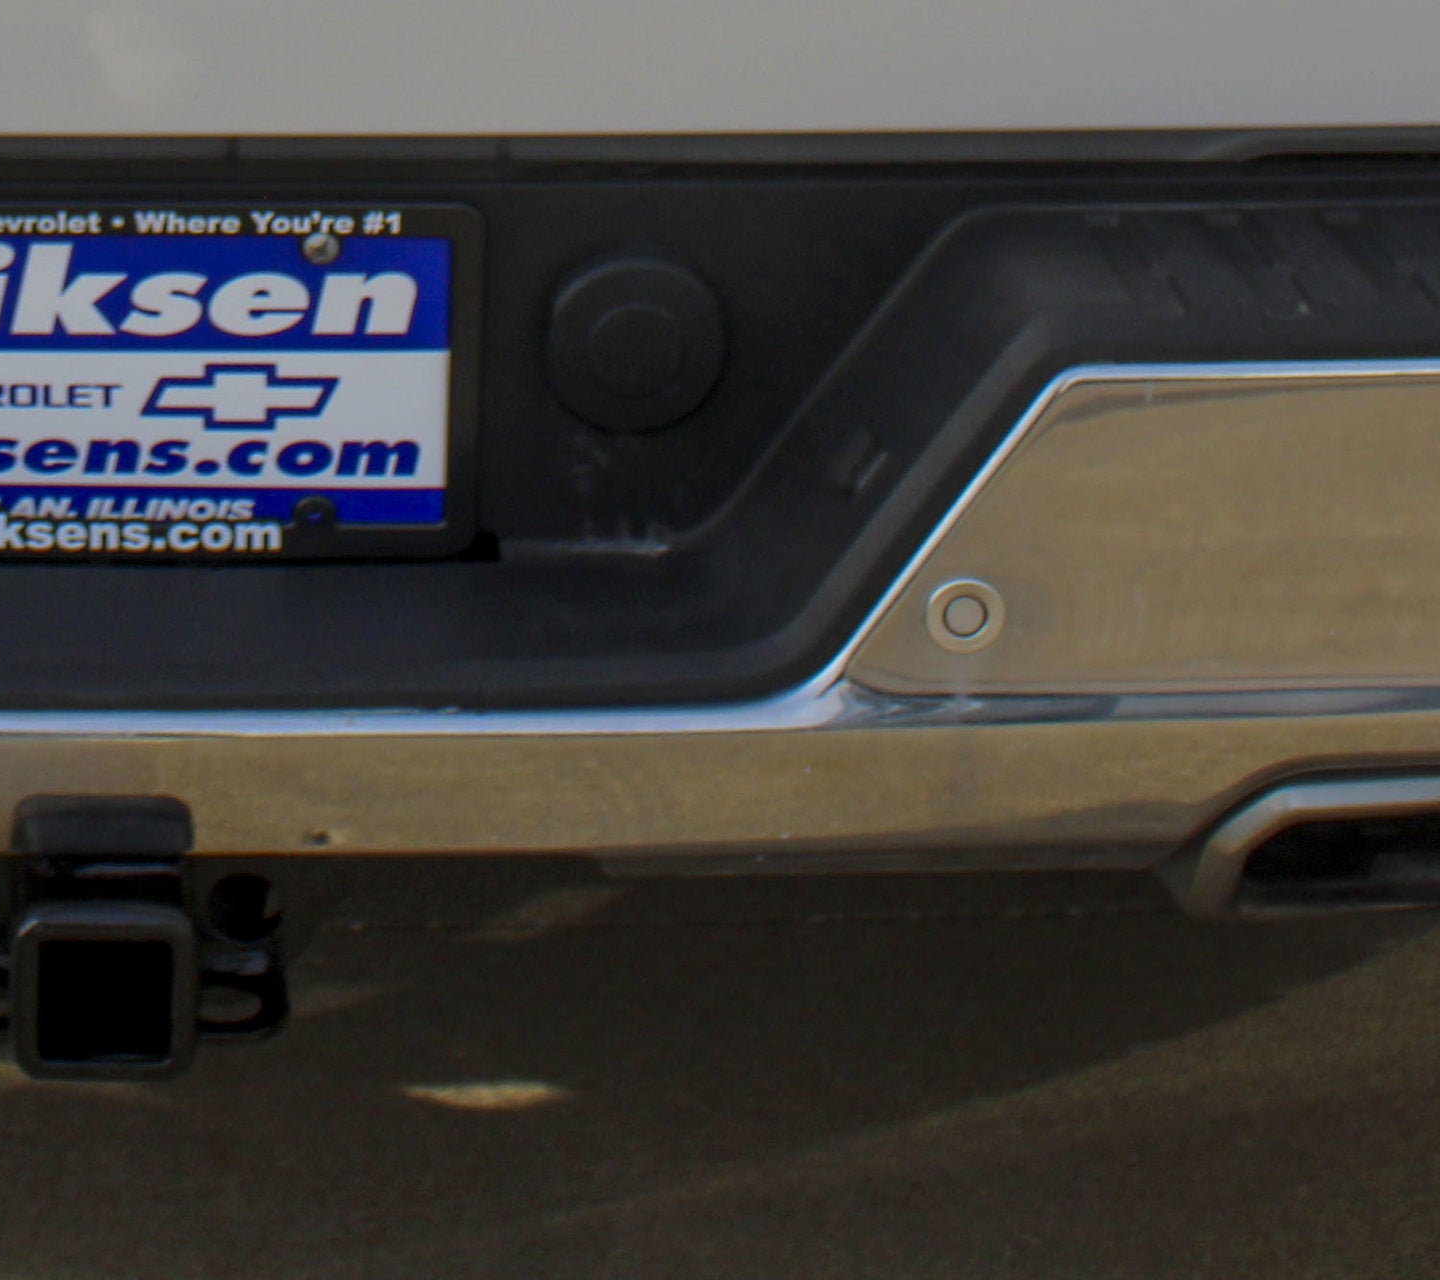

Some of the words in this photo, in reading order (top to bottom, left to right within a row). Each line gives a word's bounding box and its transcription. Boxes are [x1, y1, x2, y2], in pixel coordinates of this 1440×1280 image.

[134, 210, 241, 235] Where
[362, 212, 403, 234] #1
[85, 497, 256, 521] ILLINOIS
